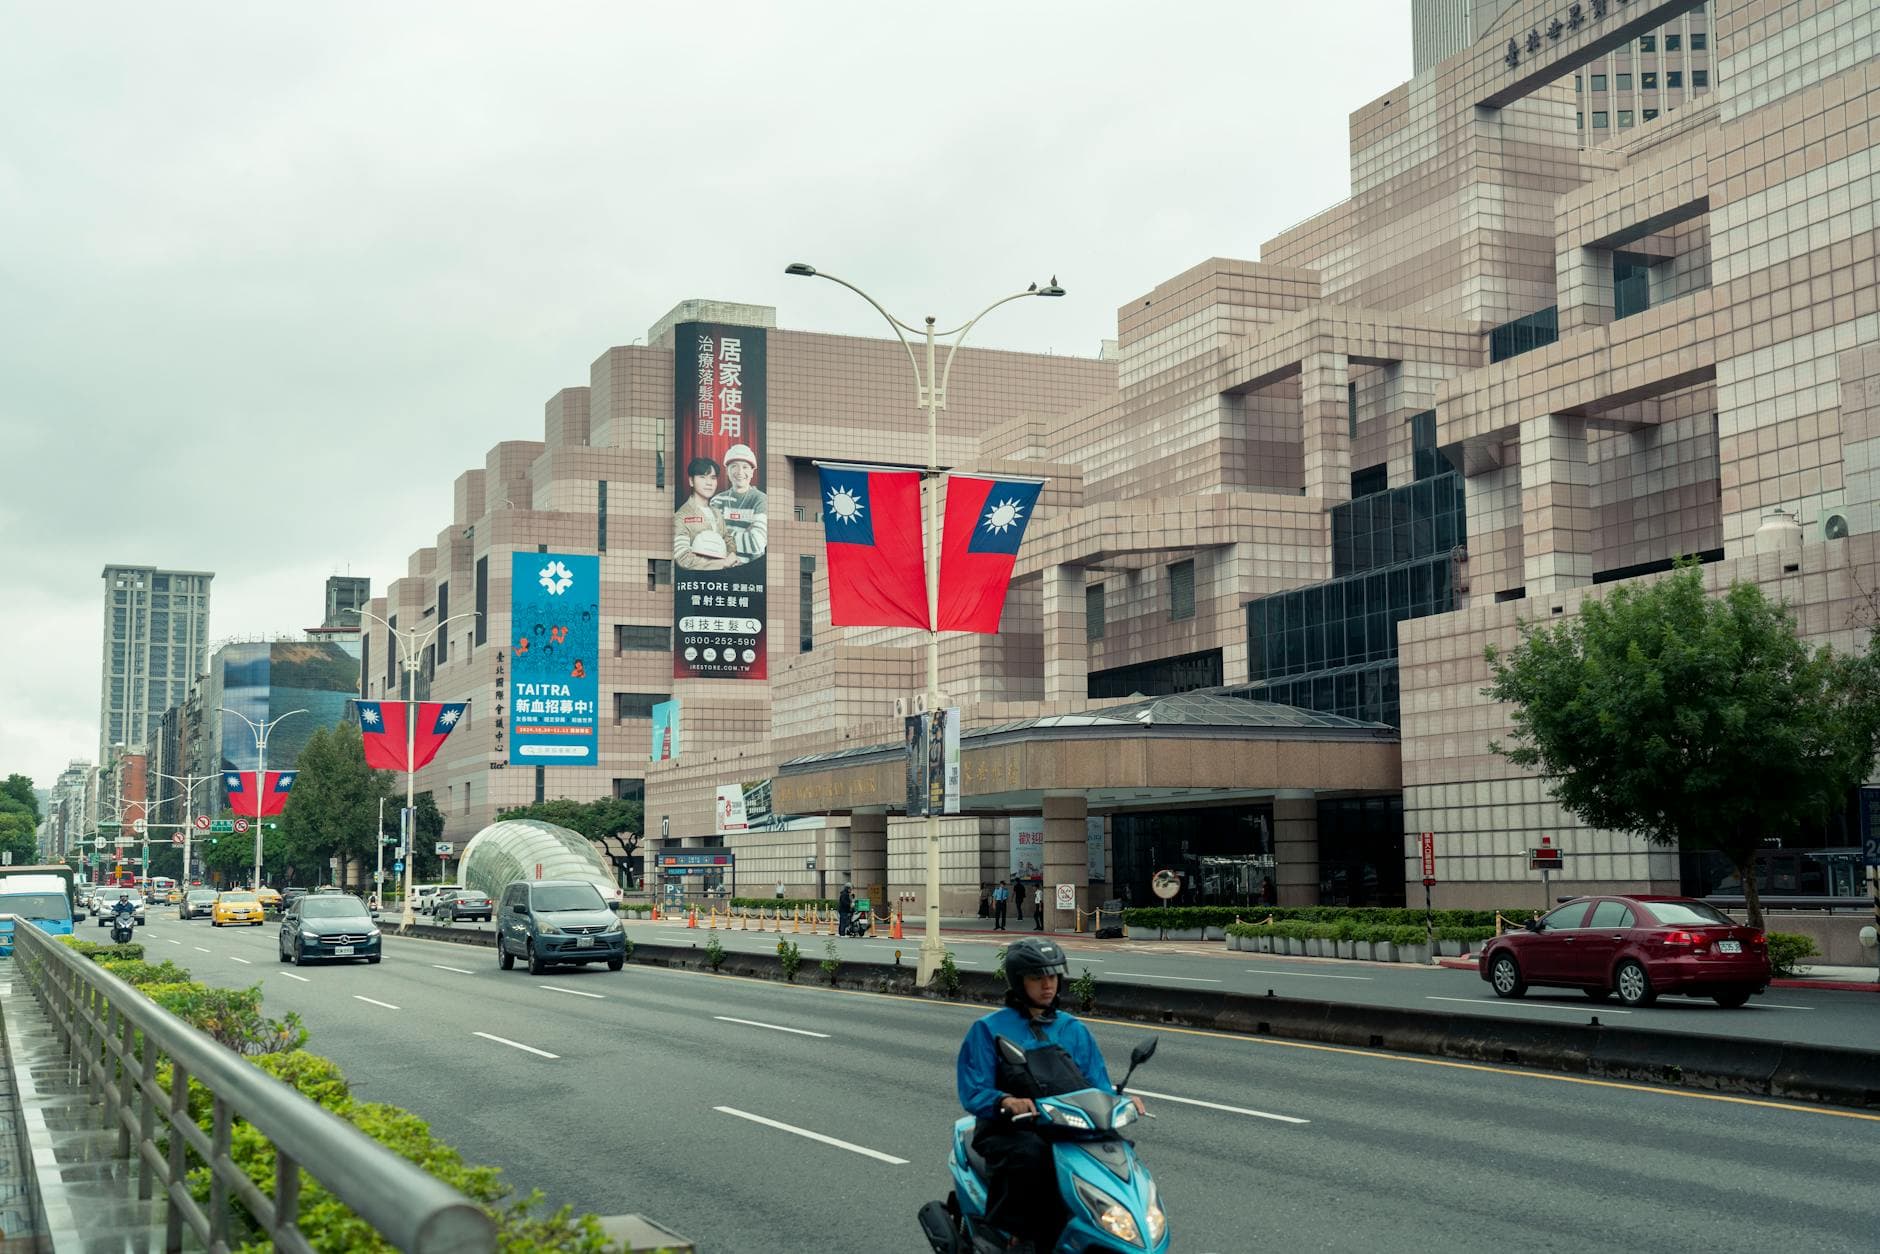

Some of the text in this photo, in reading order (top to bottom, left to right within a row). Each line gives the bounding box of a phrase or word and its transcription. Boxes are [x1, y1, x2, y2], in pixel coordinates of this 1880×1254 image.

[698, 335, 714, 435] 治療落髮問題
[719, 338, 742, 437] 居家使用
[677, 581, 729, 591] iRESTORE
[691, 594, 749, 608] 雷射生髮帽
[684, 618, 739, 631] 科技生髮
[684, 636, 756, 646] 0800-252-590
[516, 683, 571, 697] TAITRA
[515, 698, 594, 715] 新血招募中!
[666, 884, 674, 894] P
